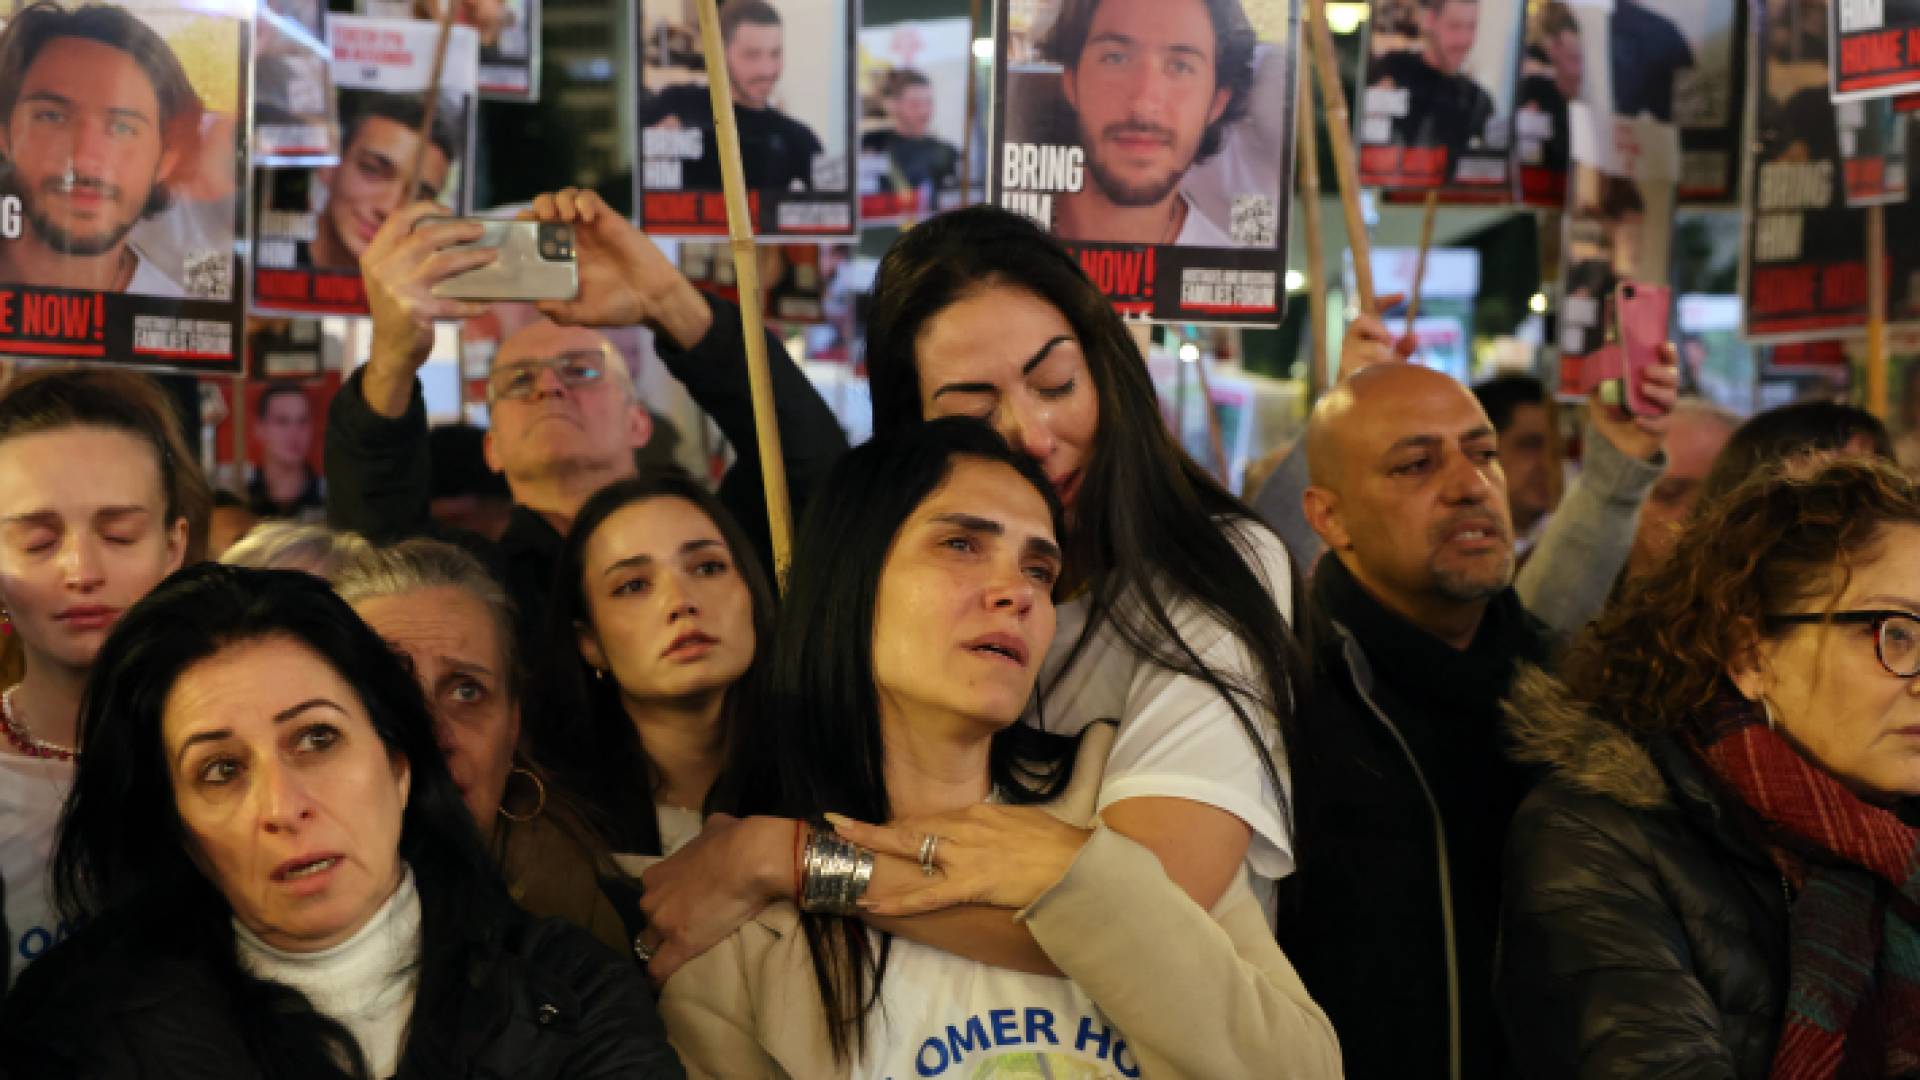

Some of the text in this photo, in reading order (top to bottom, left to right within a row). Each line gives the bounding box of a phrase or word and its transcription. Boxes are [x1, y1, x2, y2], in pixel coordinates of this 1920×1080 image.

[1002, 142, 1084, 193] BRING
[21, 293, 104, 341] NOW!
[915, 1007, 1058, 1078] OMER
